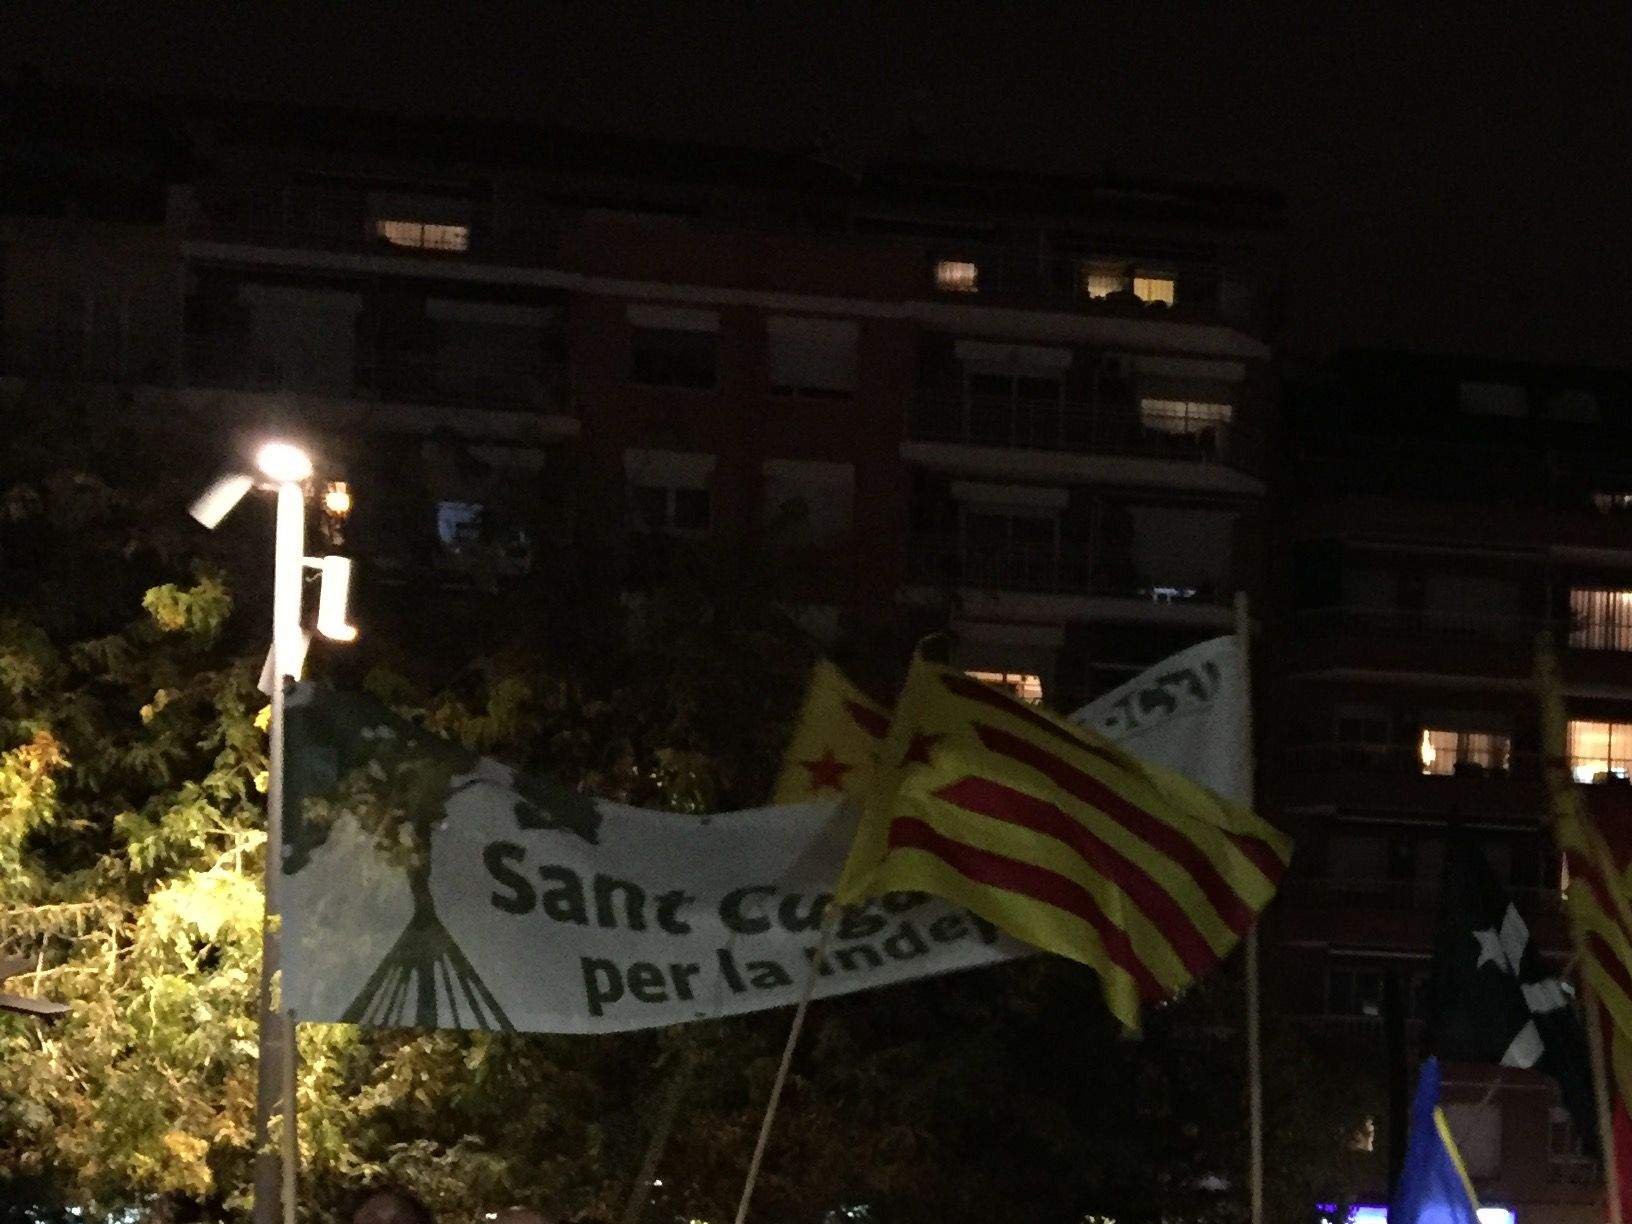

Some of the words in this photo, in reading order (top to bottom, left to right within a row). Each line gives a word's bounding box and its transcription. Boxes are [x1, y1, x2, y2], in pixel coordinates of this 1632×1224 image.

[483, 841, 695, 934] Sant
[580, 956, 700, 1016] per
[717, 948, 793, 993] la
